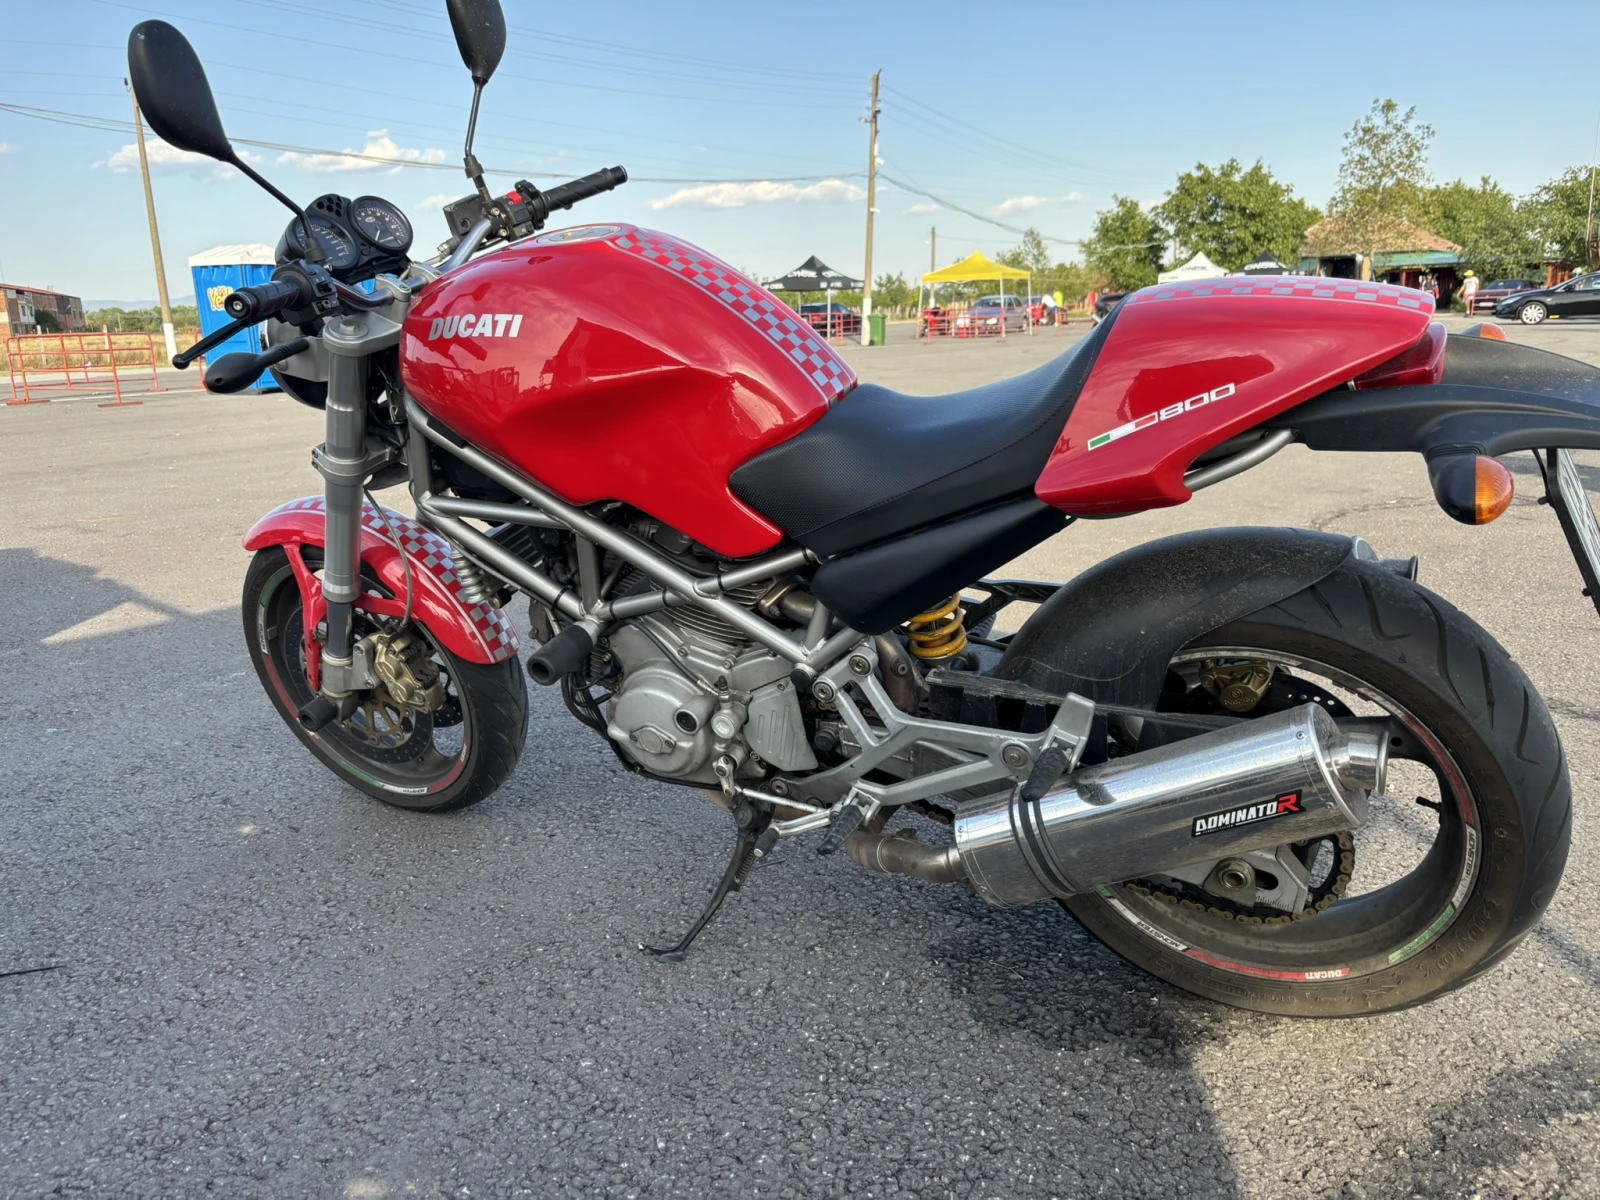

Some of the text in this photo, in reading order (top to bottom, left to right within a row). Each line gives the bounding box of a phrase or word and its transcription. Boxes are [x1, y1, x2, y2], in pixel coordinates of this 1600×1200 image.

[428, 313, 523, 341] DUCATI
[1159, 383, 1236, 421] 800
[1195, 793, 1300, 832] DOMINATOR
[1465, 831, 1475, 876] MONSTER
[1137, 921, 1180, 947] MONSTER
[1304, 969, 1343, 979] DUCATI
